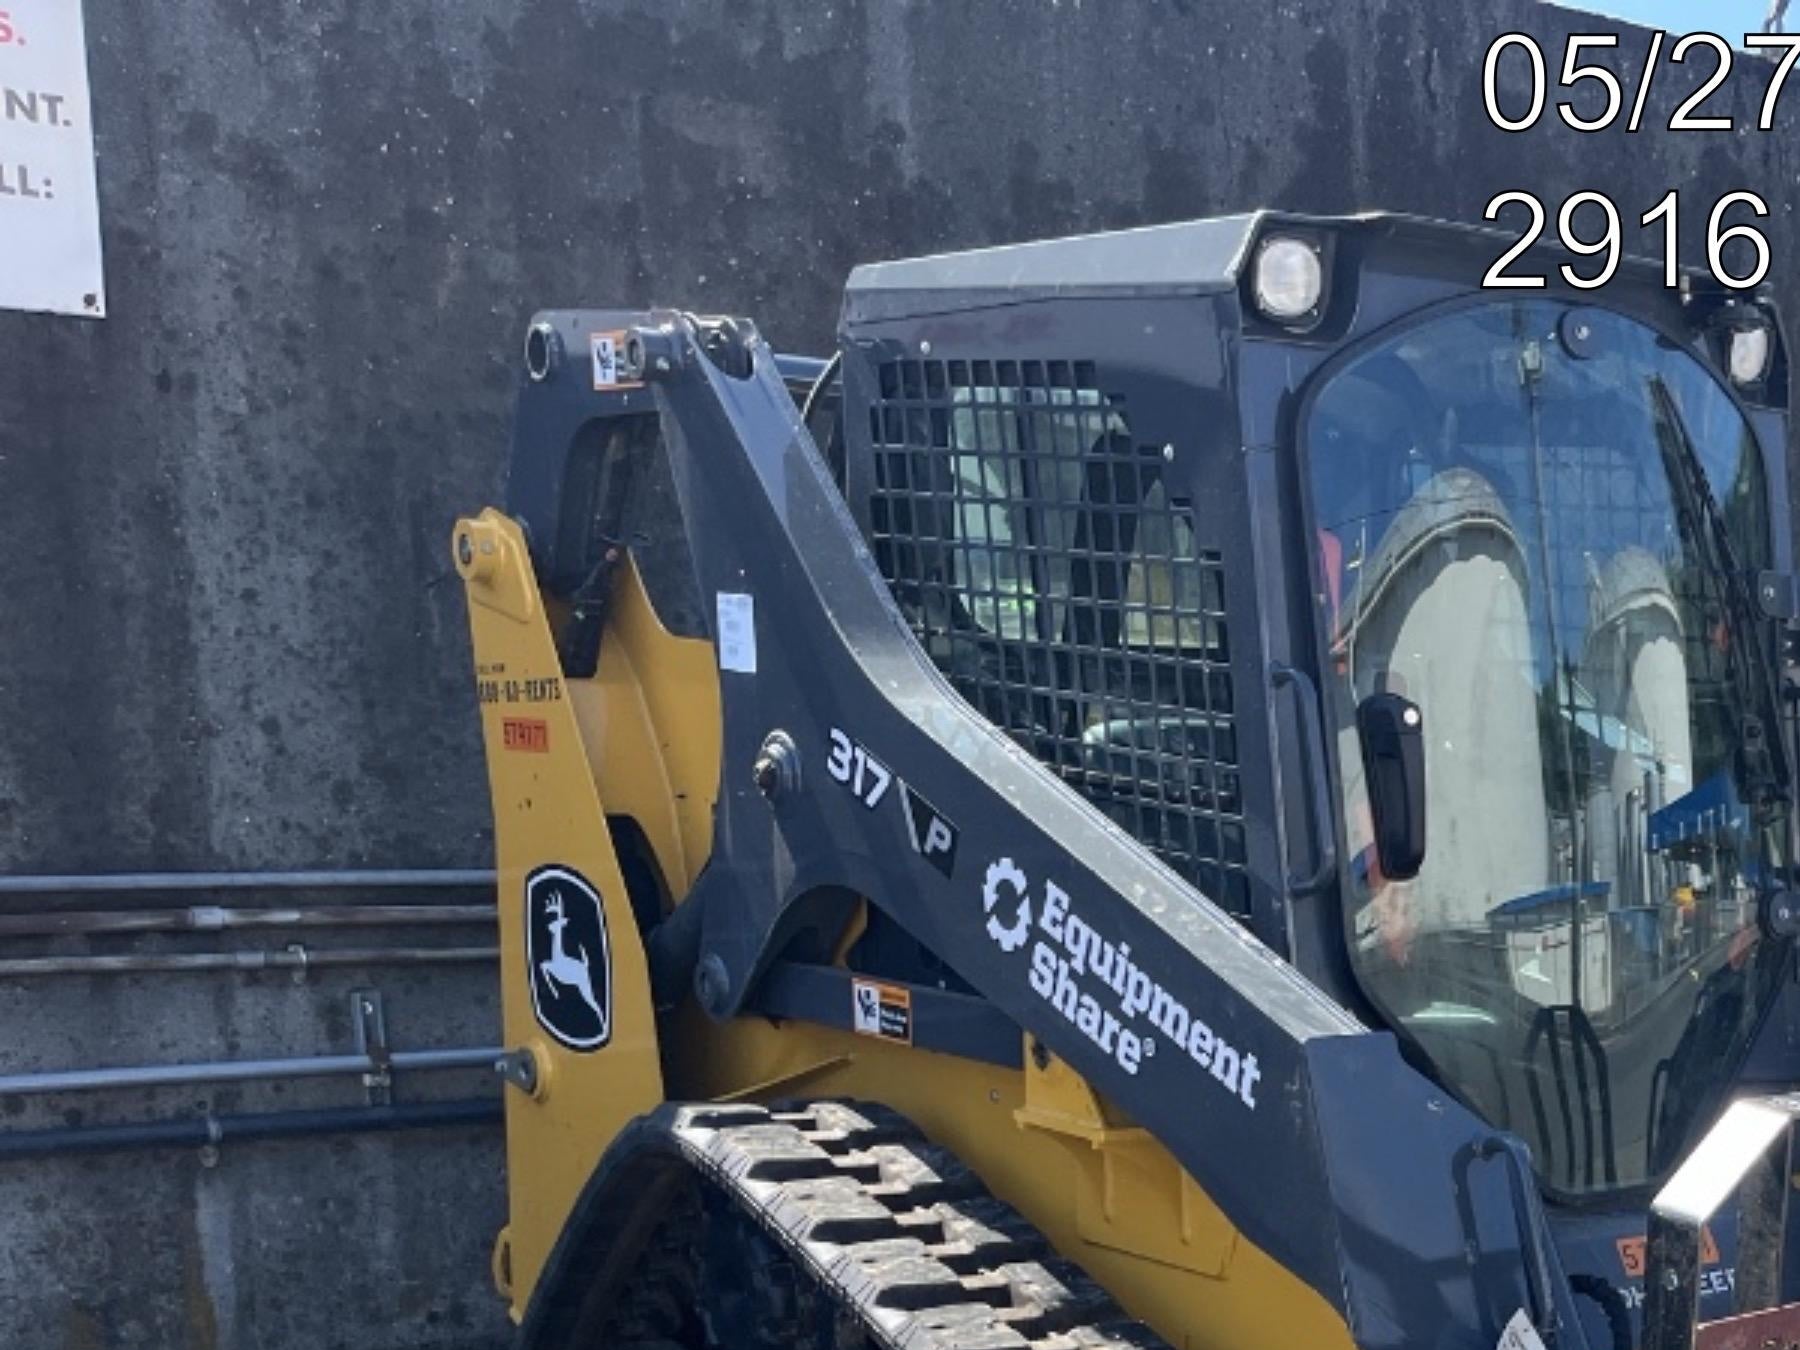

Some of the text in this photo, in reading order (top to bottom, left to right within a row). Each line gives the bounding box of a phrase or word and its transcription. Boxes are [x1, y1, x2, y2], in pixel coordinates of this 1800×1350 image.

[826, 726, 954, 855] 317 P
[1037, 877, 1262, 1111] Equipment
